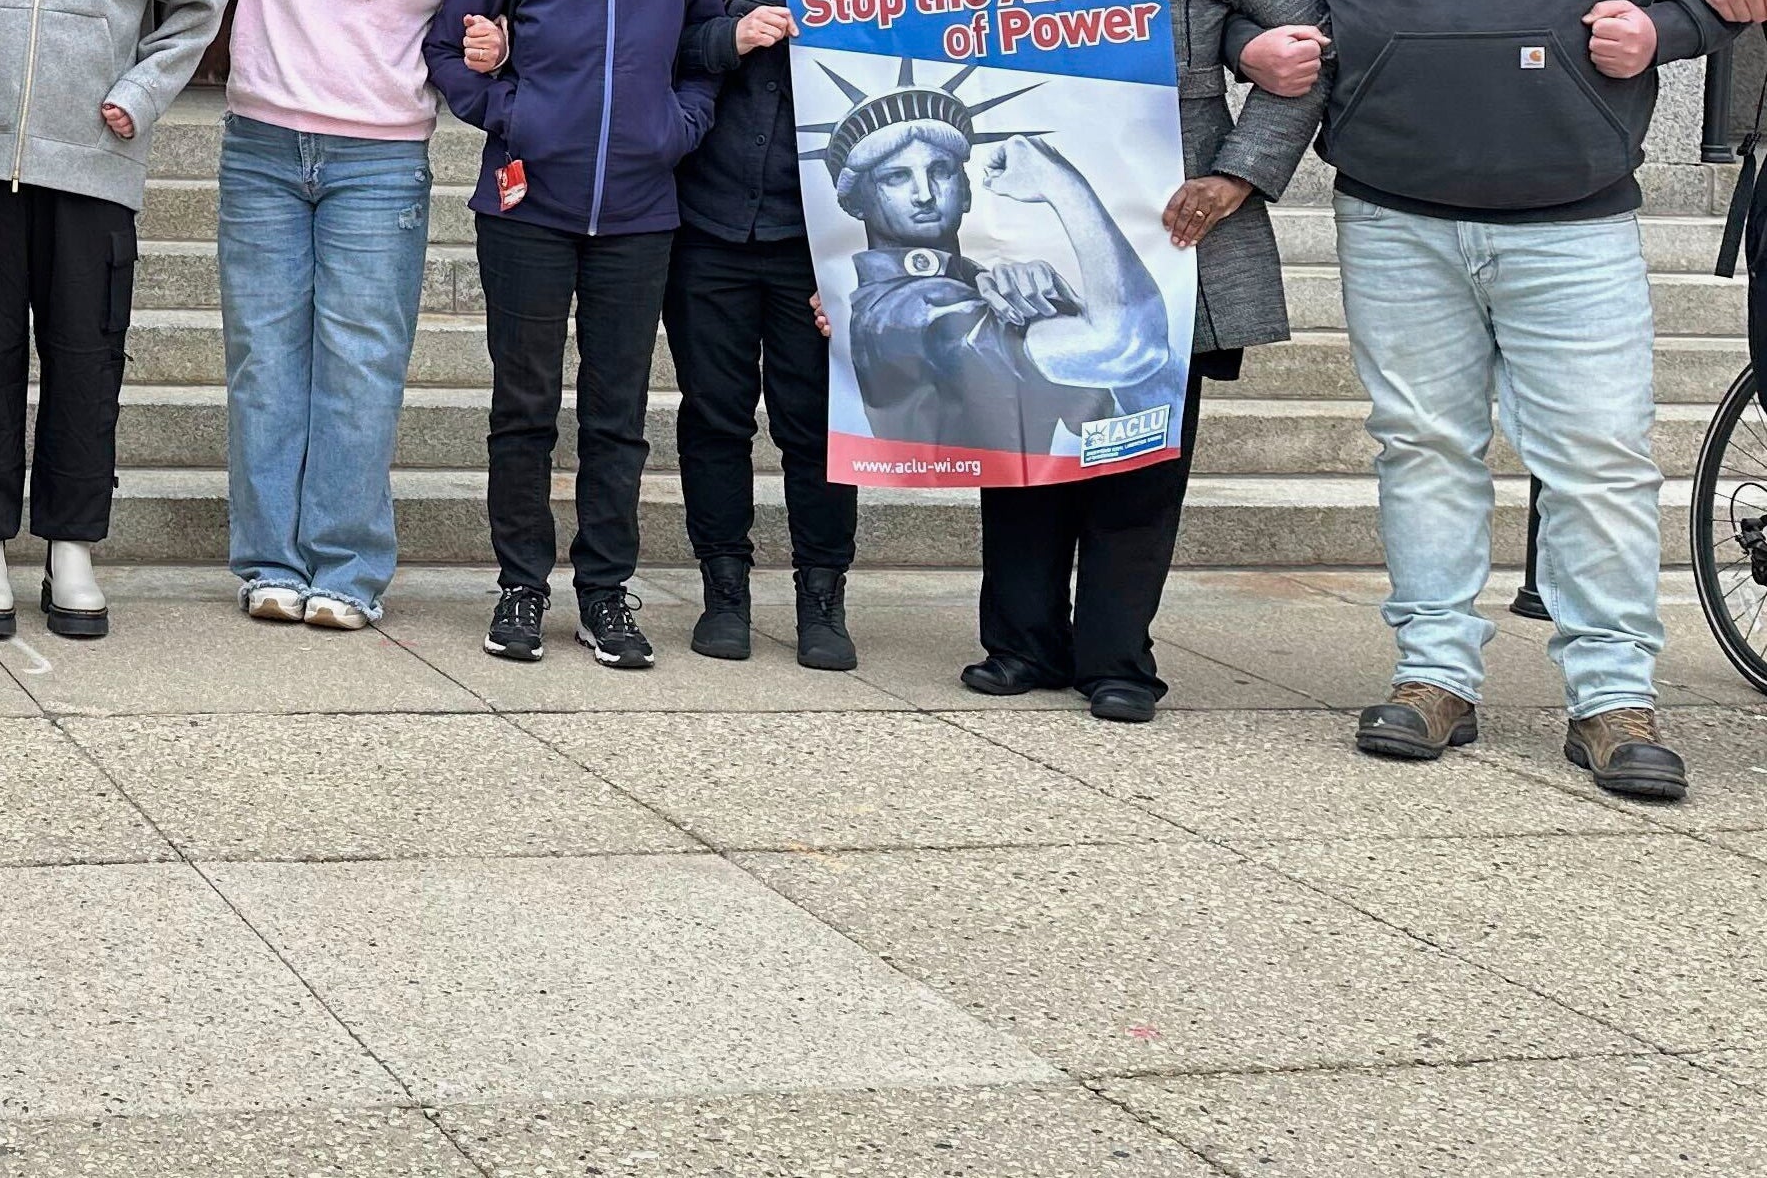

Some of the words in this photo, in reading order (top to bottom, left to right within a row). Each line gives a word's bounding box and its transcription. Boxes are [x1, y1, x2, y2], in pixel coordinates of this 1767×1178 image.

[944, 10, 990, 60] of
[997, 2, 1162, 56] Power
[1112, 409, 1165, 442] ACLU
[852, 457, 981, 476] www.aclu-wi.org
